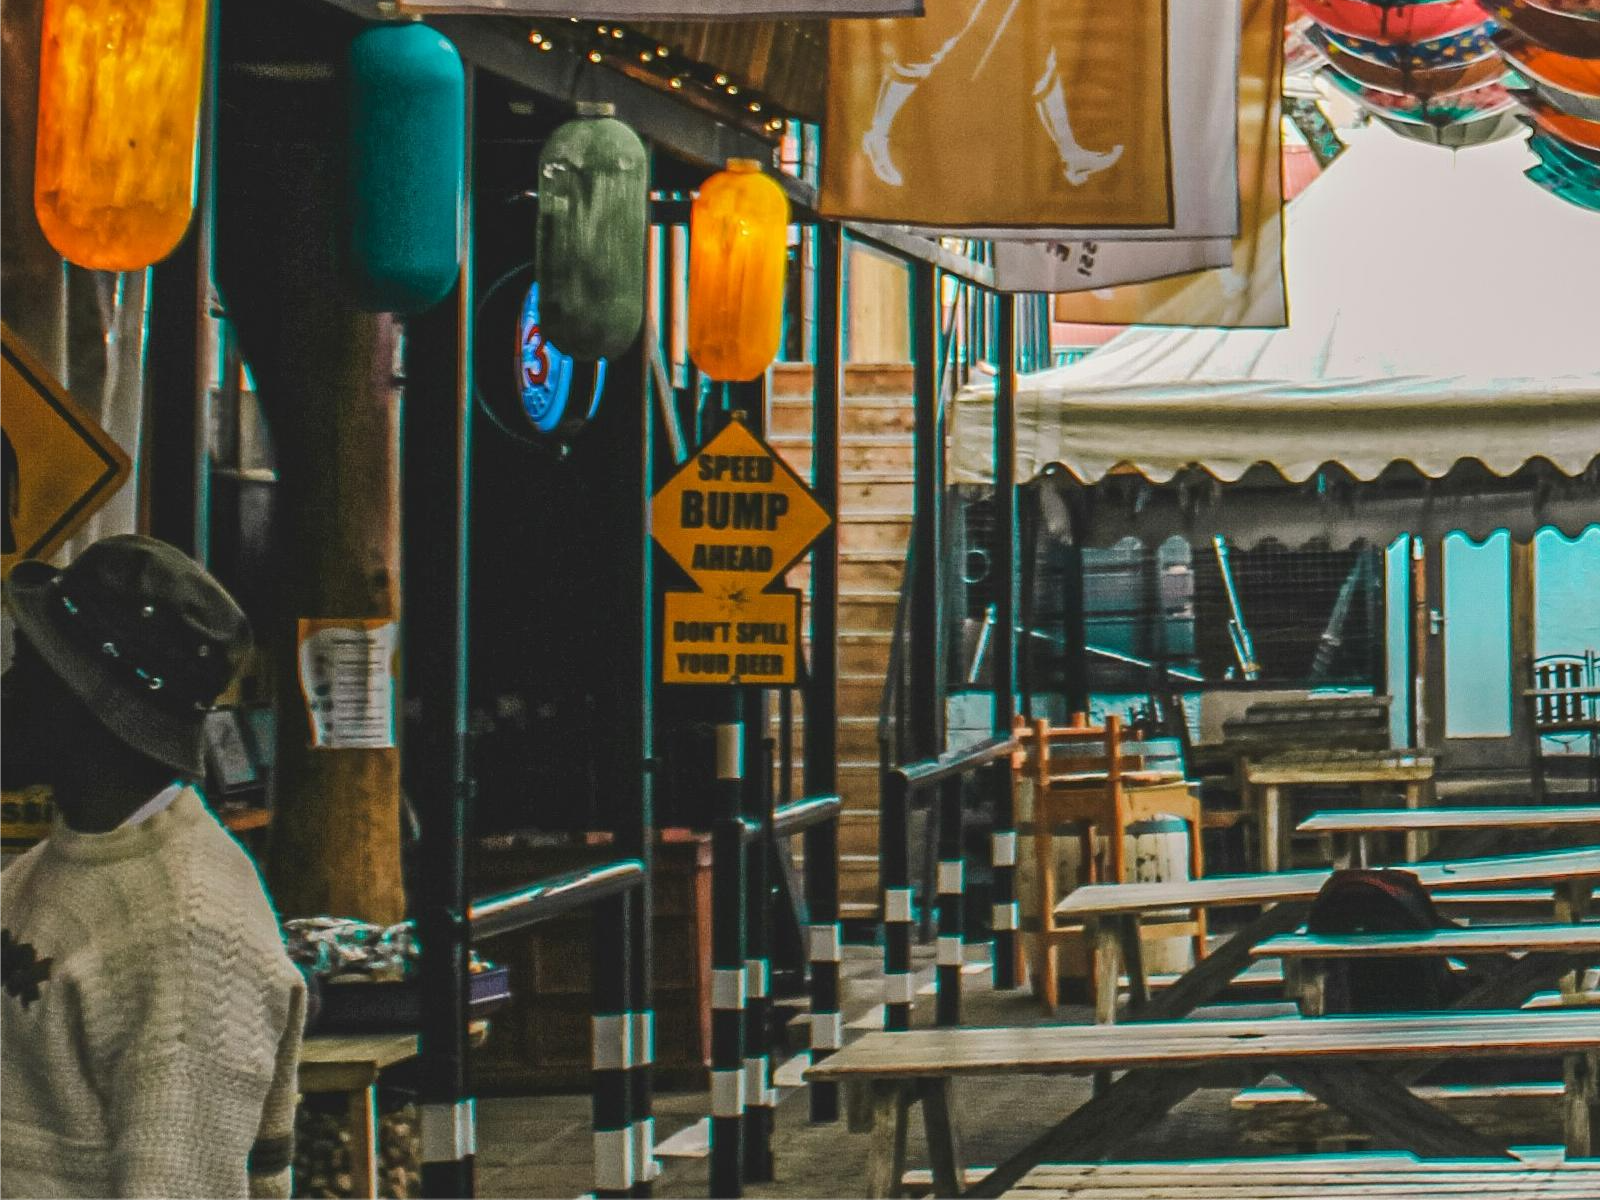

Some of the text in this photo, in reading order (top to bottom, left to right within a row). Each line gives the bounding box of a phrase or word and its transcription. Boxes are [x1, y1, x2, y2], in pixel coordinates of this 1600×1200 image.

[698, 455, 774, 483] SPEED
[681, 490, 789, 531] BUMP
[692, 544, 774, 572] AHEAD
[673, 621, 789, 645] DON'T SPILL
[677, 653, 784, 676] YOUR BEER
